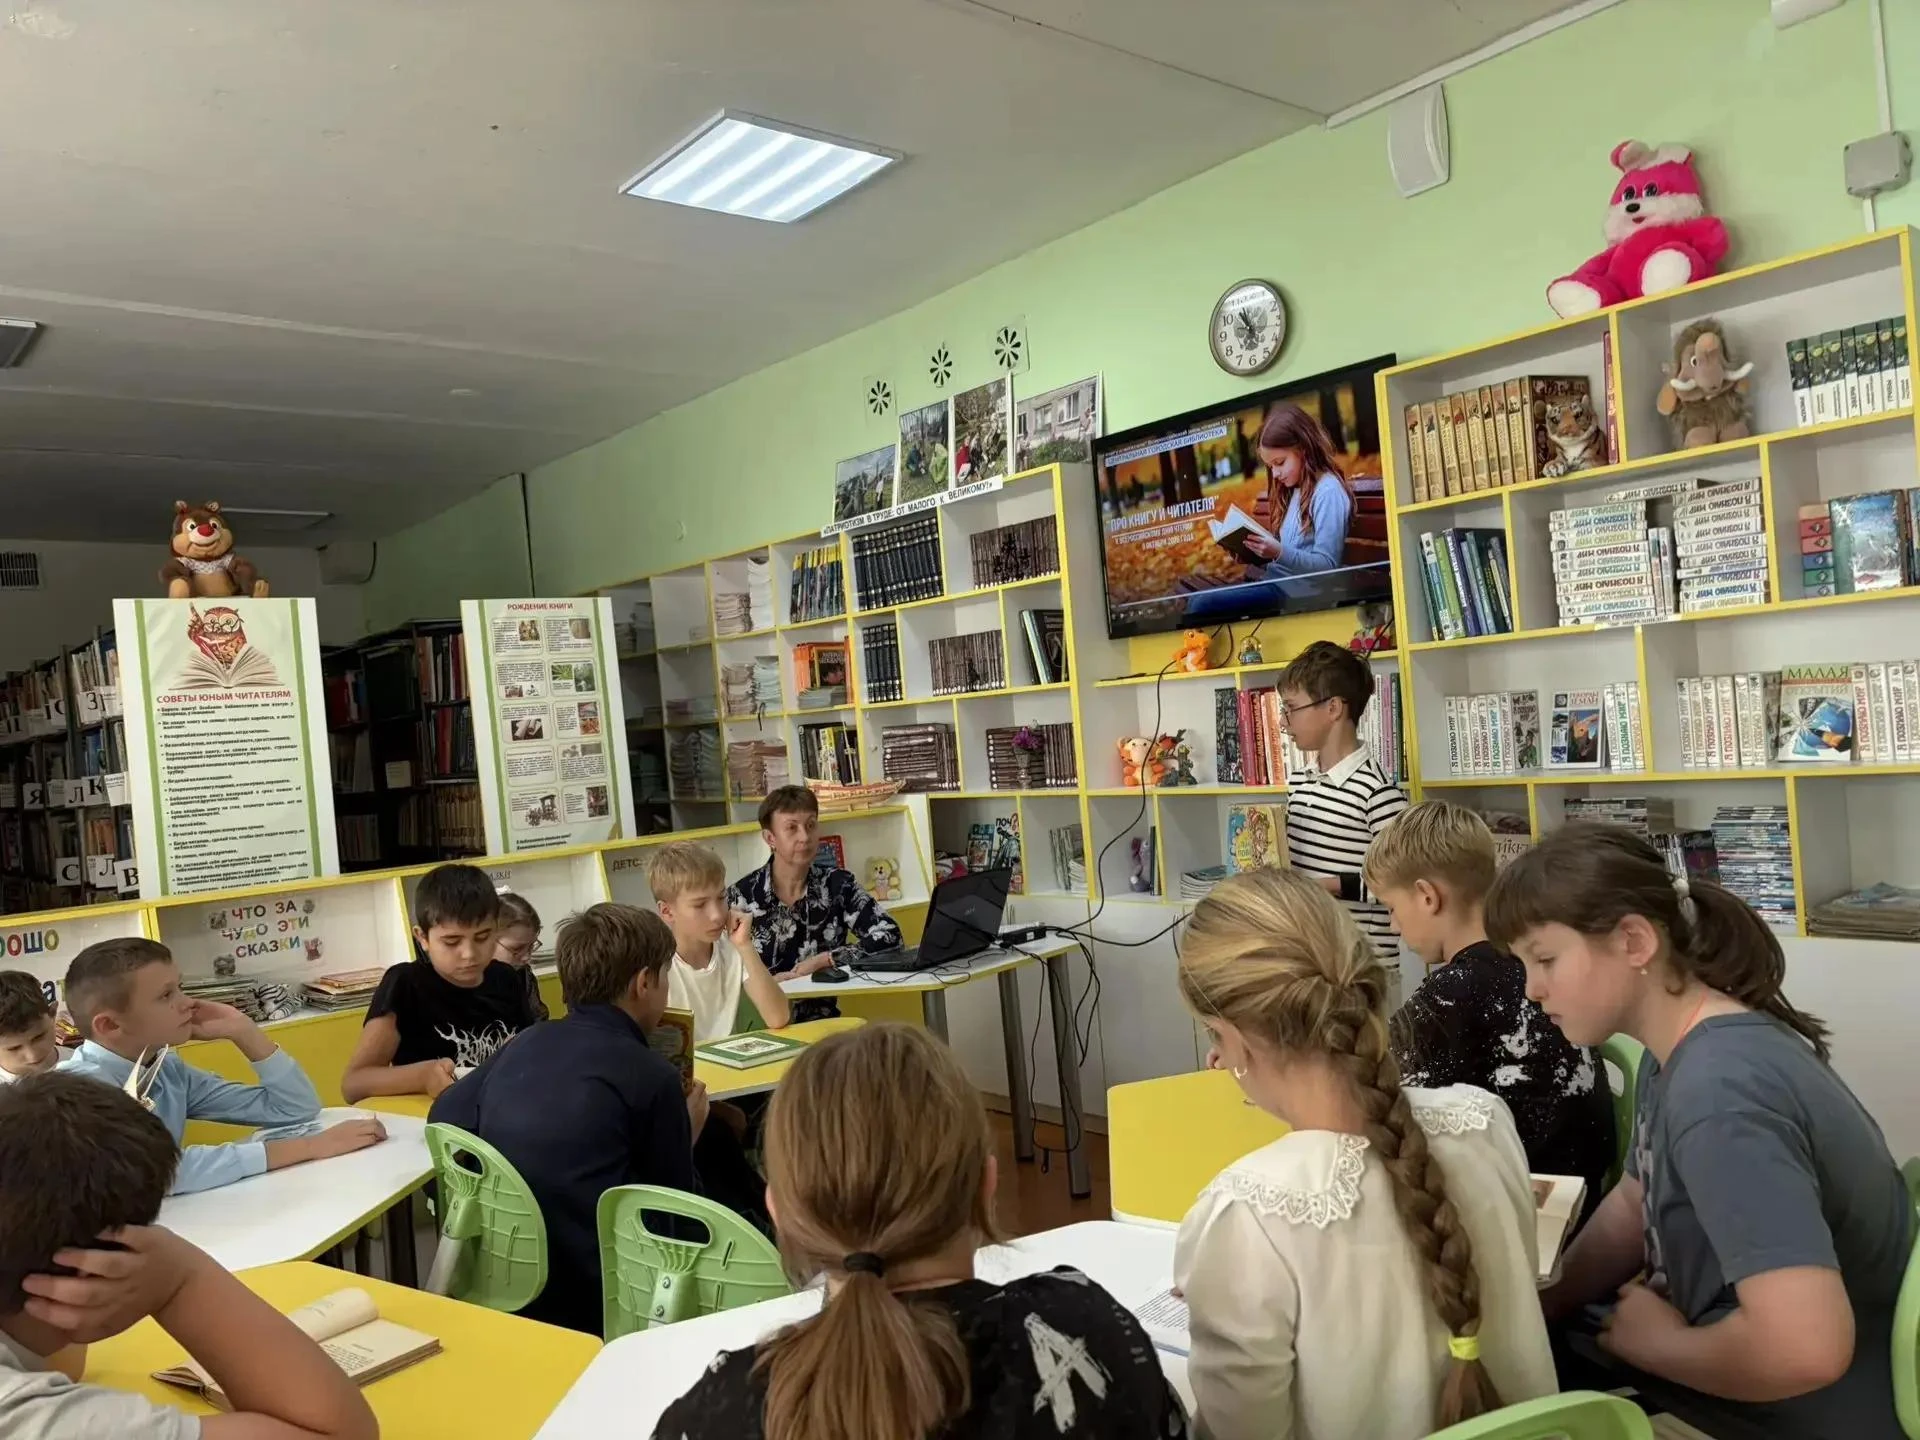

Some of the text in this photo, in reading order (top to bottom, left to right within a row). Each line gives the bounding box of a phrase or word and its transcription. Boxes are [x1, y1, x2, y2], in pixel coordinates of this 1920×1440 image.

[1223, 314, 1234, 326] 10
[1220, 331, 1227, 342] 9
[1226, 345, 1233, 356] 8
[1263, 347, 1270, 360] 5
[1236, 354, 1242, 366] 7
[1248, 354, 1257, 366] 6
[1183, 428, 1224, 444] БИБЛИОТЕКА
[866, 515, 872, 524] В
[873, 509, 894, 522] ТРУДЕ:
[896, 506, 906, 516] ОТ
[908, 496, 936, 512] МАЛОГО
[940, 496, 944, 504] К
[1128, 510, 1157, 528] КНИГУ
[1159, 508, 1166, 521] И
[1167, 496, 1220, 518] ЧИТАТЕЛЯ"
[1577, 550, 1594, 558] МИР
[1596, 546, 1632, 556] ПОЗНАЮ
[1574, 582, 1592, 592] МИР
[1596, 578, 1636, 588] ПОЗНАЮ
[507, 602, 574, 611] РОЖДЕНИЕ КНИГИ
[1788, 666, 1848, 678] МАЛАЯ
[156, 690, 291, 704] СОВЕТЫ ЮНЫМ ЧИТАТЕЛЯМ
[1892, 686, 1903, 704] МИР
[1618, 702, 1627, 719] МИР
[1894, 706, 1907, 742] ПОЗНАЮ
[1620, 721, 1630, 755] ПОЗНАЮ
[124, 868, 138, 886] В
[232, 900, 297, 920] ЧТО ЗА
[277, 916, 310, 932] ЭТИ
[236, 936, 300, 958] СКАЗКИ
